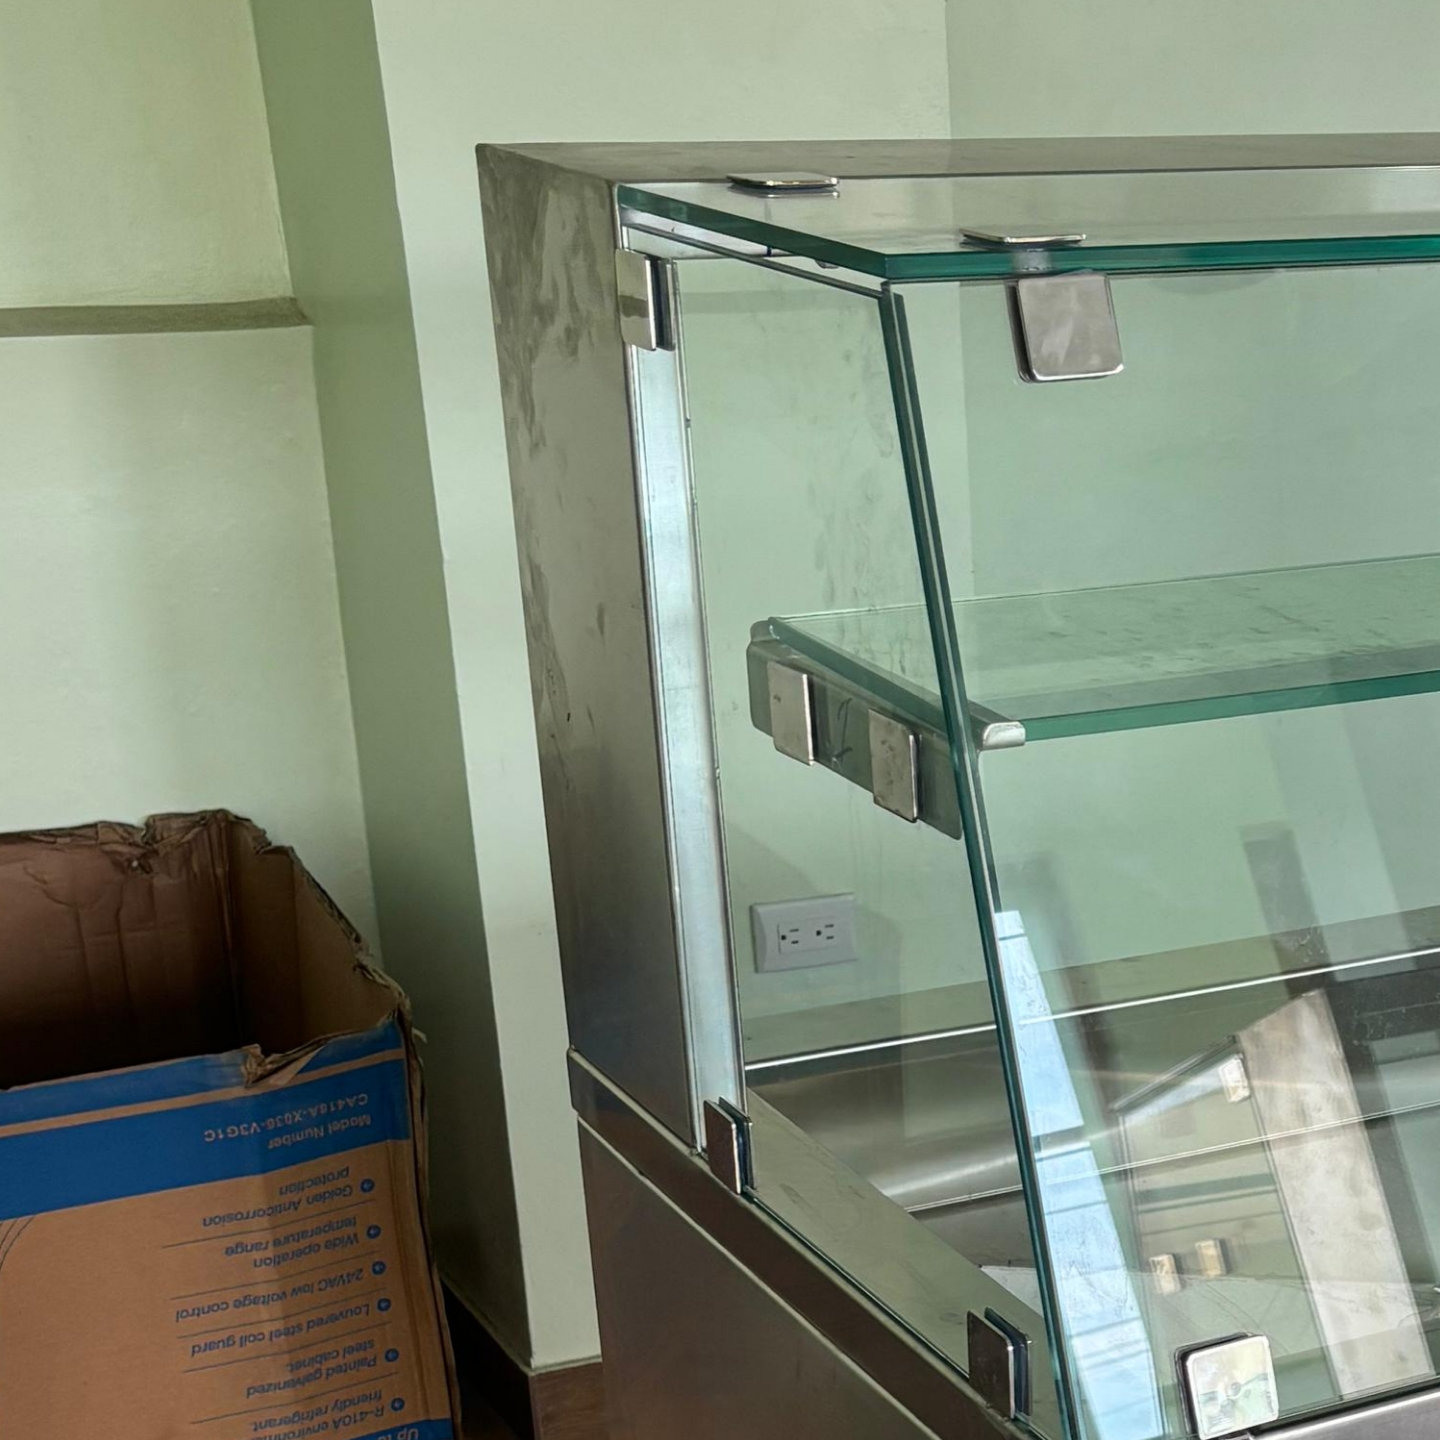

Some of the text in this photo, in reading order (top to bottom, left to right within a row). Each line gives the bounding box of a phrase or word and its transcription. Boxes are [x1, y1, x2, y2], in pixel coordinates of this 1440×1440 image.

[267, 1114, 371, 1149] Model Number
[279, 1166, 349, 1195] protection
[202, 1185, 353, 1227] Golden Anticorrosion
[224, 1216, 357, 1256] temperature range
[253, 1233, 360, 1268] Wide operation
[176, 1268, 364, 1323] 24VAC low voltage control
[191, 1303, 370, 1357] Louvered steel coil guard
[342, 1339, 375, 1357] steel
[246, 1354, 377, 1398] Painted galvanized
[332, 1389, 382, 1411] friendly
[333, 1406, 384, 1430] R-410A
